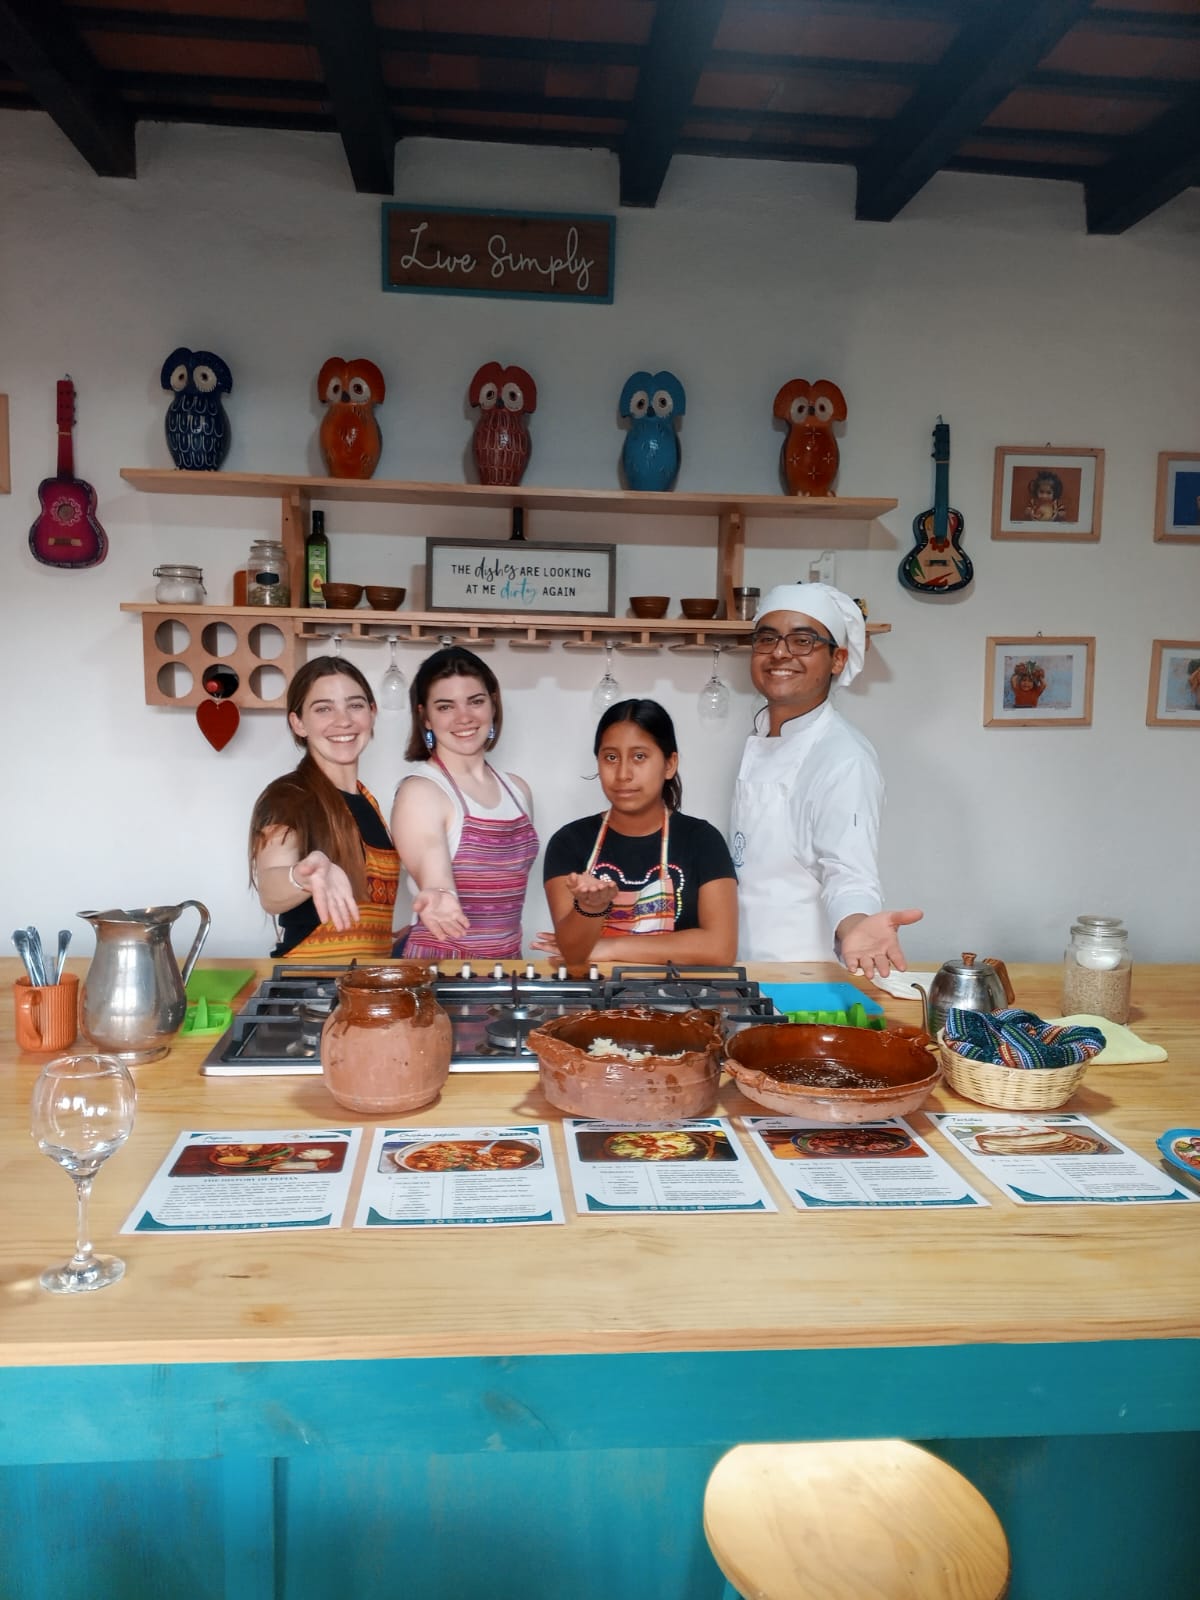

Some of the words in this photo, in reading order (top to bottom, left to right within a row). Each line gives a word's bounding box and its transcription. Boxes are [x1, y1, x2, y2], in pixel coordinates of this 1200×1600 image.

[400, 222, 477, 273] Live
[488, 226, 595, 291] Simply
[451, 564, 471, 575] THE
[474, 556, 519, 582] dishes
[520, 567, 540, 577] ARE
[544, 567, 591, 578] LOOKING
[465, 584, 478, 595] AT
[482, 585, 497, 595] ME
[500, 577, 537, 604] dirty
[542, 586, 576, 597] AGAIN
